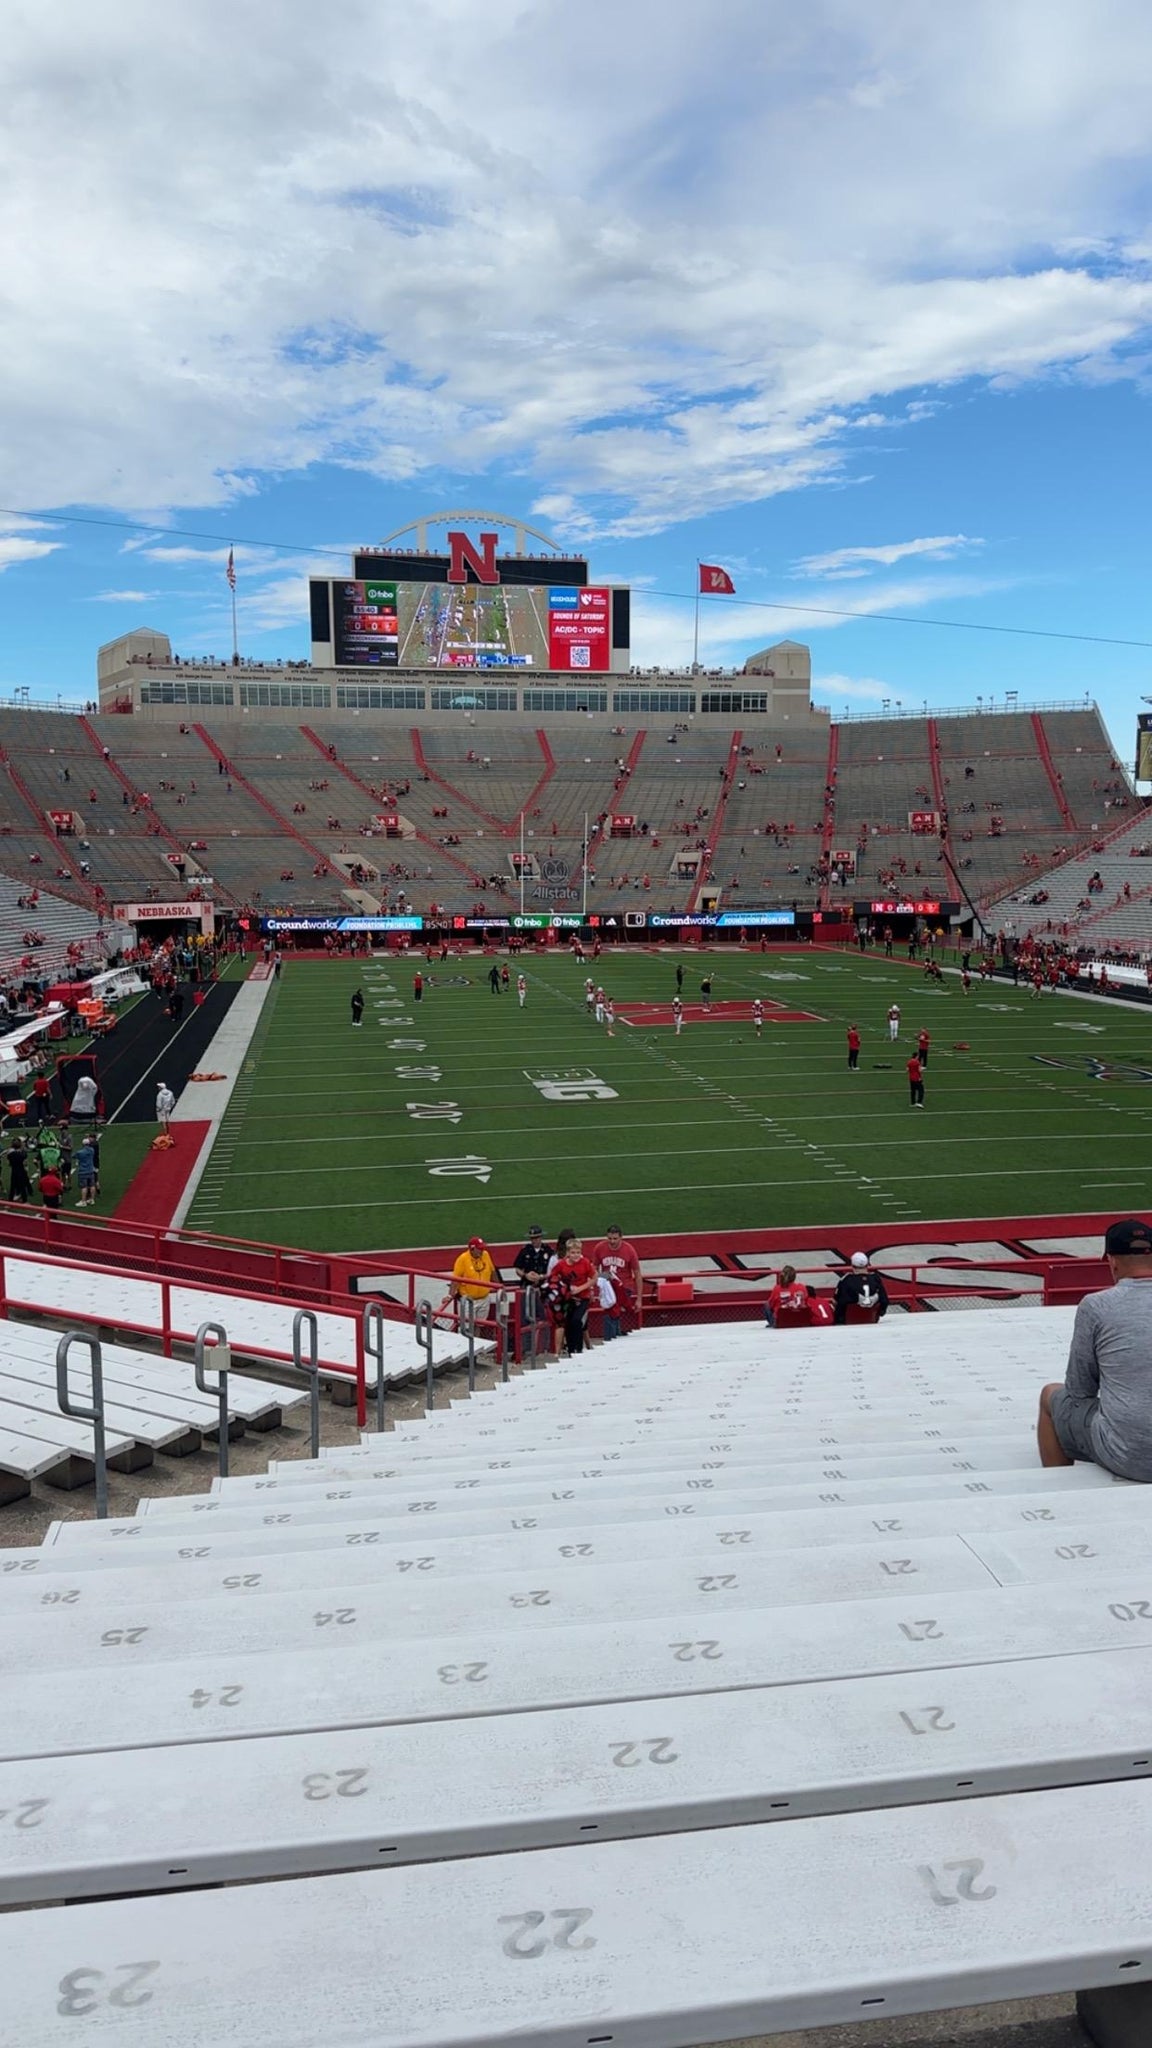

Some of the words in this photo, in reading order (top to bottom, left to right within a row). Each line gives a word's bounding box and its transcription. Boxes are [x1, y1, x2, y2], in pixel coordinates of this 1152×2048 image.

[359, 547, 439, 557] MEMORIAL
[504, 552, 584, 561] STADIUM
[447, 532, 500, 585] N
[554, 626, 578, 634] AC/DC
[582, 626, 605, 634] TOPIC
[532, 886, 578, 900] Allstate
[137, 906, 193, 917] NEBRASKA
[266, 919, 338, 930] Groundworks
[524, 918, 542, 926] fnbo
[563, 918, 580, 928] fnbo
[652, 915, 717, 925] Groundworks
[394, 1065, 443, 1079] 30
[406, 1101, 464, 1119] 20
[425, 1154, 493, 1176] 10
[818, 1304, 828, 1318] 1
[487, 1460, 512, 1470] 22
[372, 1469, 398, 1480] 23
[581, 1469, 604, 1479] 21
[453, 1479, 481, 1490] 22
[686, 1478, 715, 1489] 20
[325, 1490, 353, 1501] 23
[551, 1490, 576, 1501] 21
[191, 1502, 220, 1512] 24
[407, 1500, 438, 1513] 22
[664, 1504, 696, 1516] 20
[261, 1513, 292, 1525] 23
[1020, 1508, 1056, 1522] 20
[510, 1518, 539, 1530] 21
[871, 1519, 904, 1533] 21
[345, 1531, 381, 1545] 22
[715, 1530, 754, 1546] 22
[177, 1546, 212, 1560] 23
[557, 1543, 595, 1559] 23
[1054, 1543, 1100, 1561] 20
[395, 1556, 436, 1573] 24
[878, 1559, 919, 1576] 21
[221, 1573, 263, 1590] 25
[697, 1573, 741, 1594] 22
[508, 1589, 552, 1609] 23
[312, 1607, 357, 1628] 24
[1107, 1600, 1152, 1622] 20
[100, 1626, 150, 1648] 25
[897, 1619, 945, 1642] 21
[667, 1639, 724, 1663] 22
[436, 1661, 489, 1685] 23
[188, 1684, 244, 1710] 24
[898, 1705, 956, 1736] 21
[607, 1736, 681, 1769] 22
[301, 1767, 369, 1802] 23
[0, 1797, 51, 1830] 2
[916, 1858, 998, 1907] 21
[496, 1907, 598, 1960] 22
[56, 1960, 162, 2018] 23
